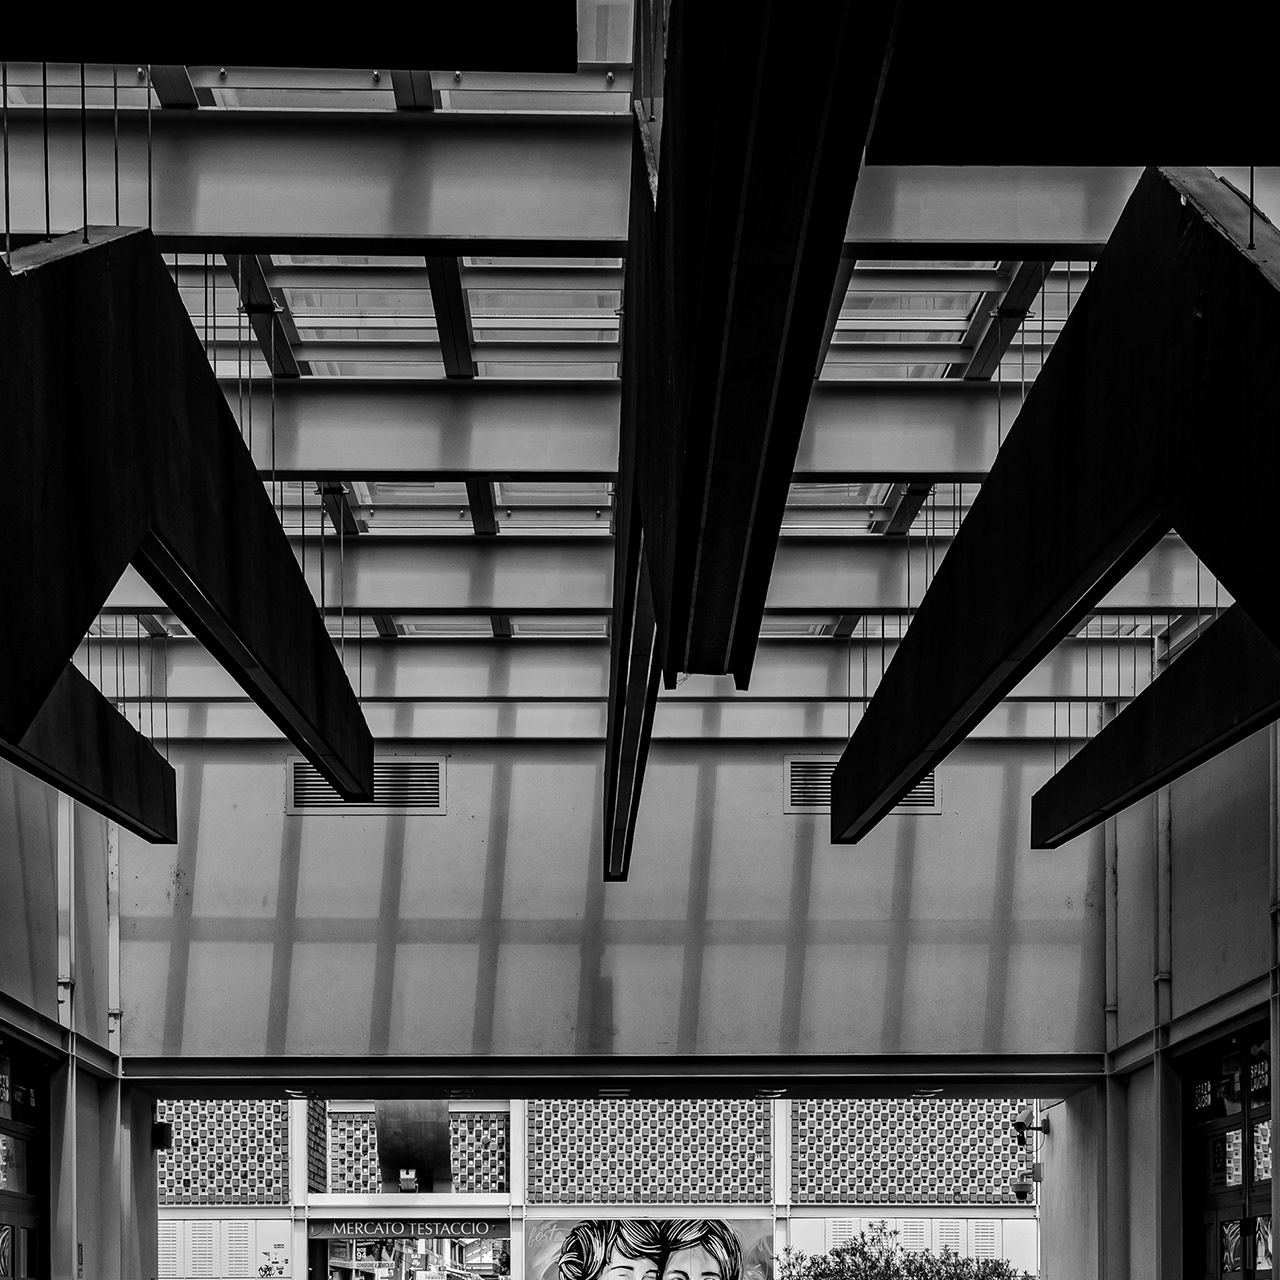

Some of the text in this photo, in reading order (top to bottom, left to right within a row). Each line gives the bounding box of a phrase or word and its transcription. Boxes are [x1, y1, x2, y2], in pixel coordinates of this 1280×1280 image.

[332, 1222, 489, 1235] MERCATO TESTACCIO
[356, 1252, 367, 1260] 94
